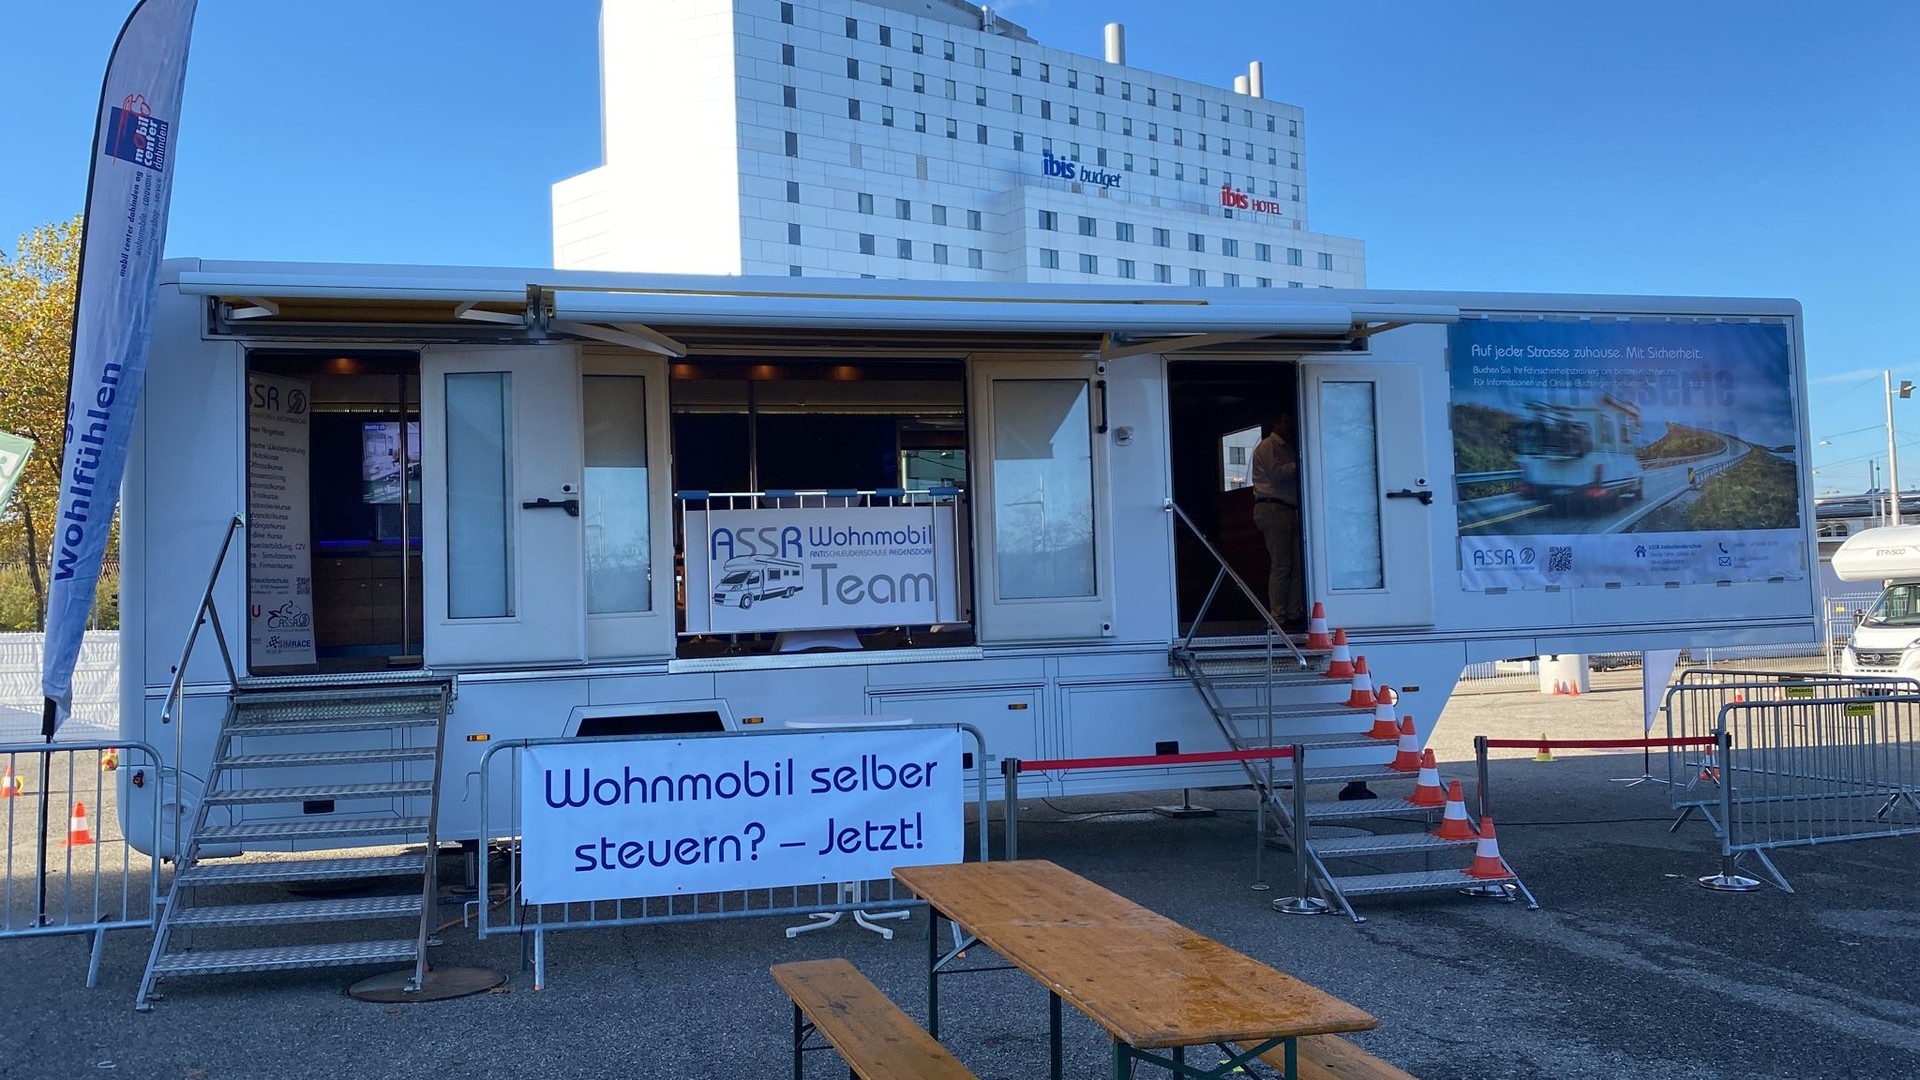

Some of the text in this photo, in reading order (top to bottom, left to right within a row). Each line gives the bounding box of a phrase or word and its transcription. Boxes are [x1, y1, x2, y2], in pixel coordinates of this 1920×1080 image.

[134, 116, 149, 163] mobil
[143, 119, 158, 167] center
[152, 123, 168, 170] dahinden
[1042, 151, 1122, 189] ibis budget
[141, 173, 152, 207] caravans
[1221, 184, 1283, 215] ibis HOTEL
[119, 171, 144, 278] mobil center dahinden ag
[1471, 344, 1704, 361] Auf jeder Strasse zuhause. Mit Sicherheit.
[1472, 365, 1500, 374] Buchen
[1500, 366, 1511, 374] Sie
[1473, 378, 1485, 387] Für
[1486, 378, 1534, 387] Informationen
[1535, 379, 1548, 388] und
[54, 361, 122, 581] wohlfühlen
[711, 524, 932, 561] ASSR Wohnmobil
[809, 547, 934, 558] ANTISCHLEUDERSCHULE REGENSDORF
[1473, 548, 1516, 566] ASSR
[810, 562, 935, 606] Team
[278, 639, 311, 648] SIMRACE
[1847, 703, 1875, 712] Condecta
[544, 753, 938, 810] Wohnmobil selber
[574, 820, 767, 873] steuern?
[818, 811, 924, 856] Jetzt!
